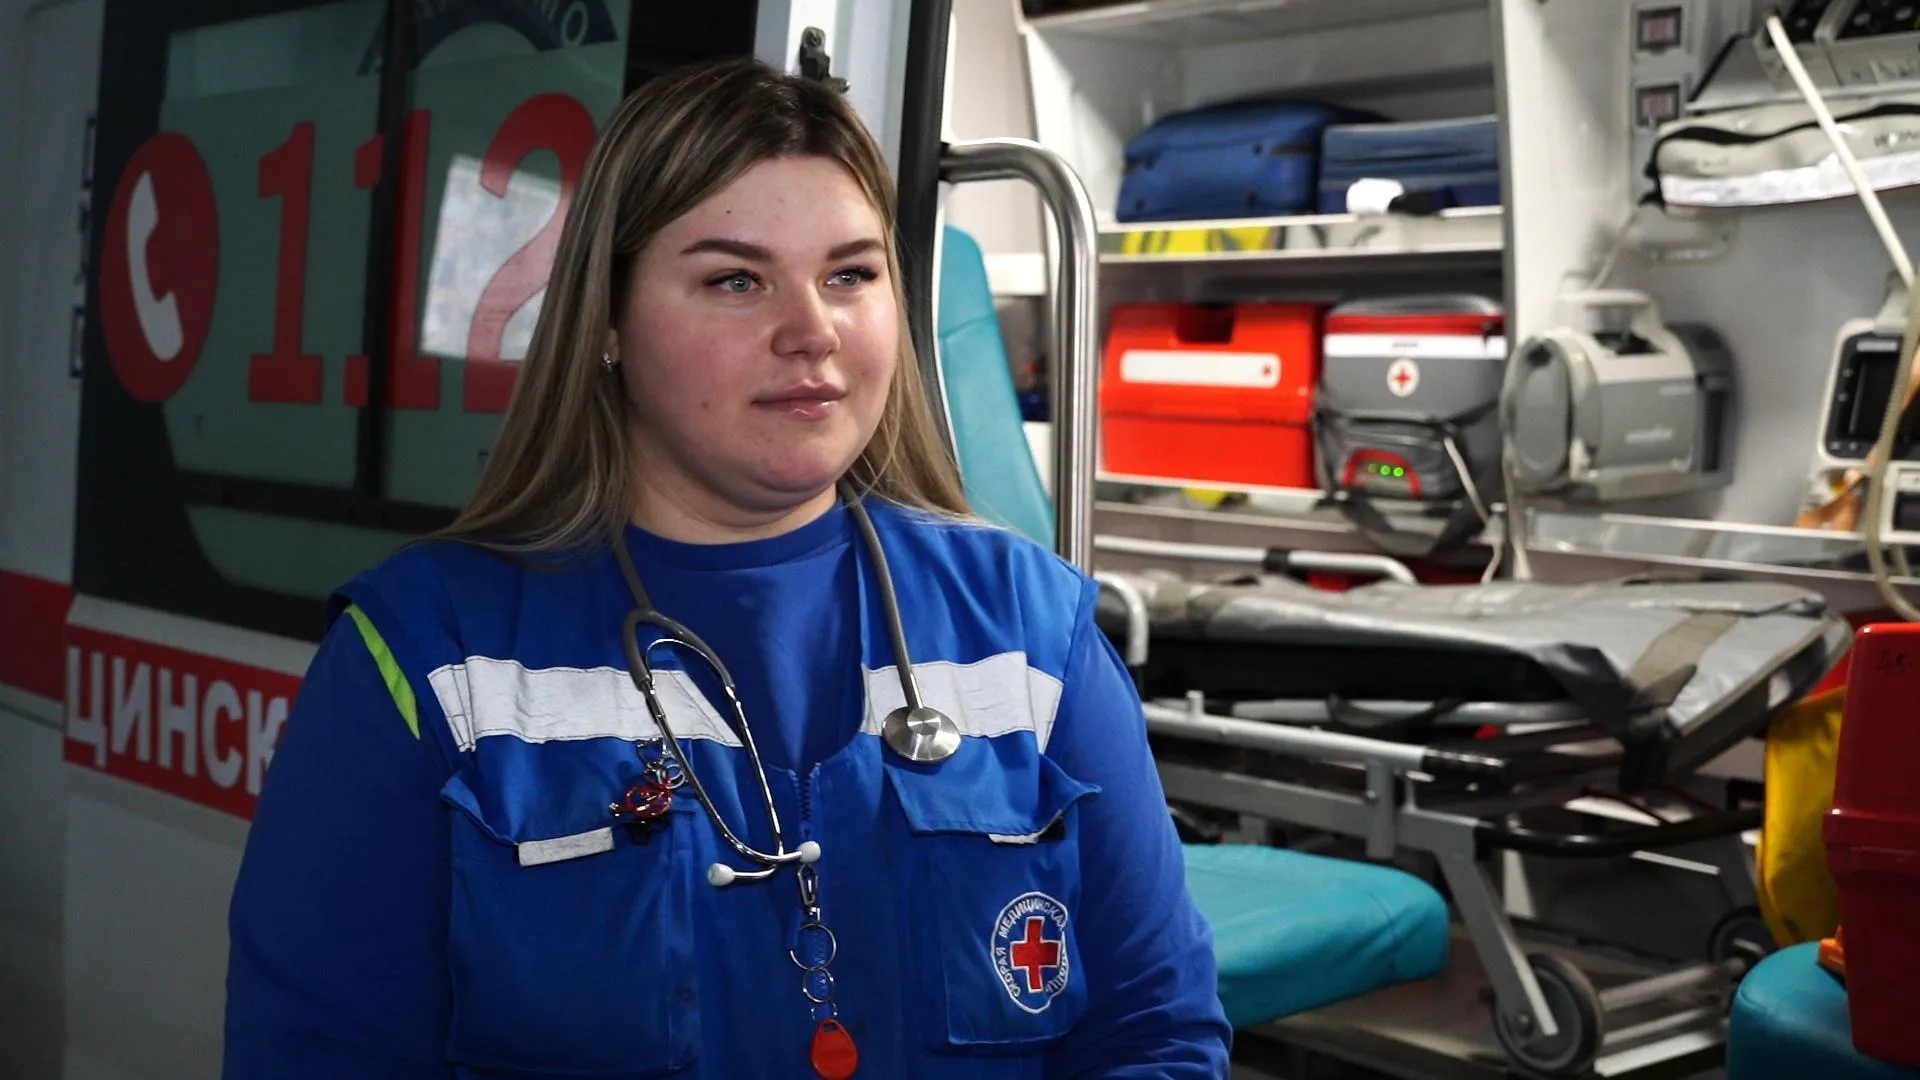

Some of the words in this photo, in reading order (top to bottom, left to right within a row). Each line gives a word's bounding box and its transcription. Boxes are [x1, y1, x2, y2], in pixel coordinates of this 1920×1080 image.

[248, 92, 597, 413] 112
[66, 646, 288, 795] ЦИНСК
[996, 947, 1021, 998] СКОРАЯ
